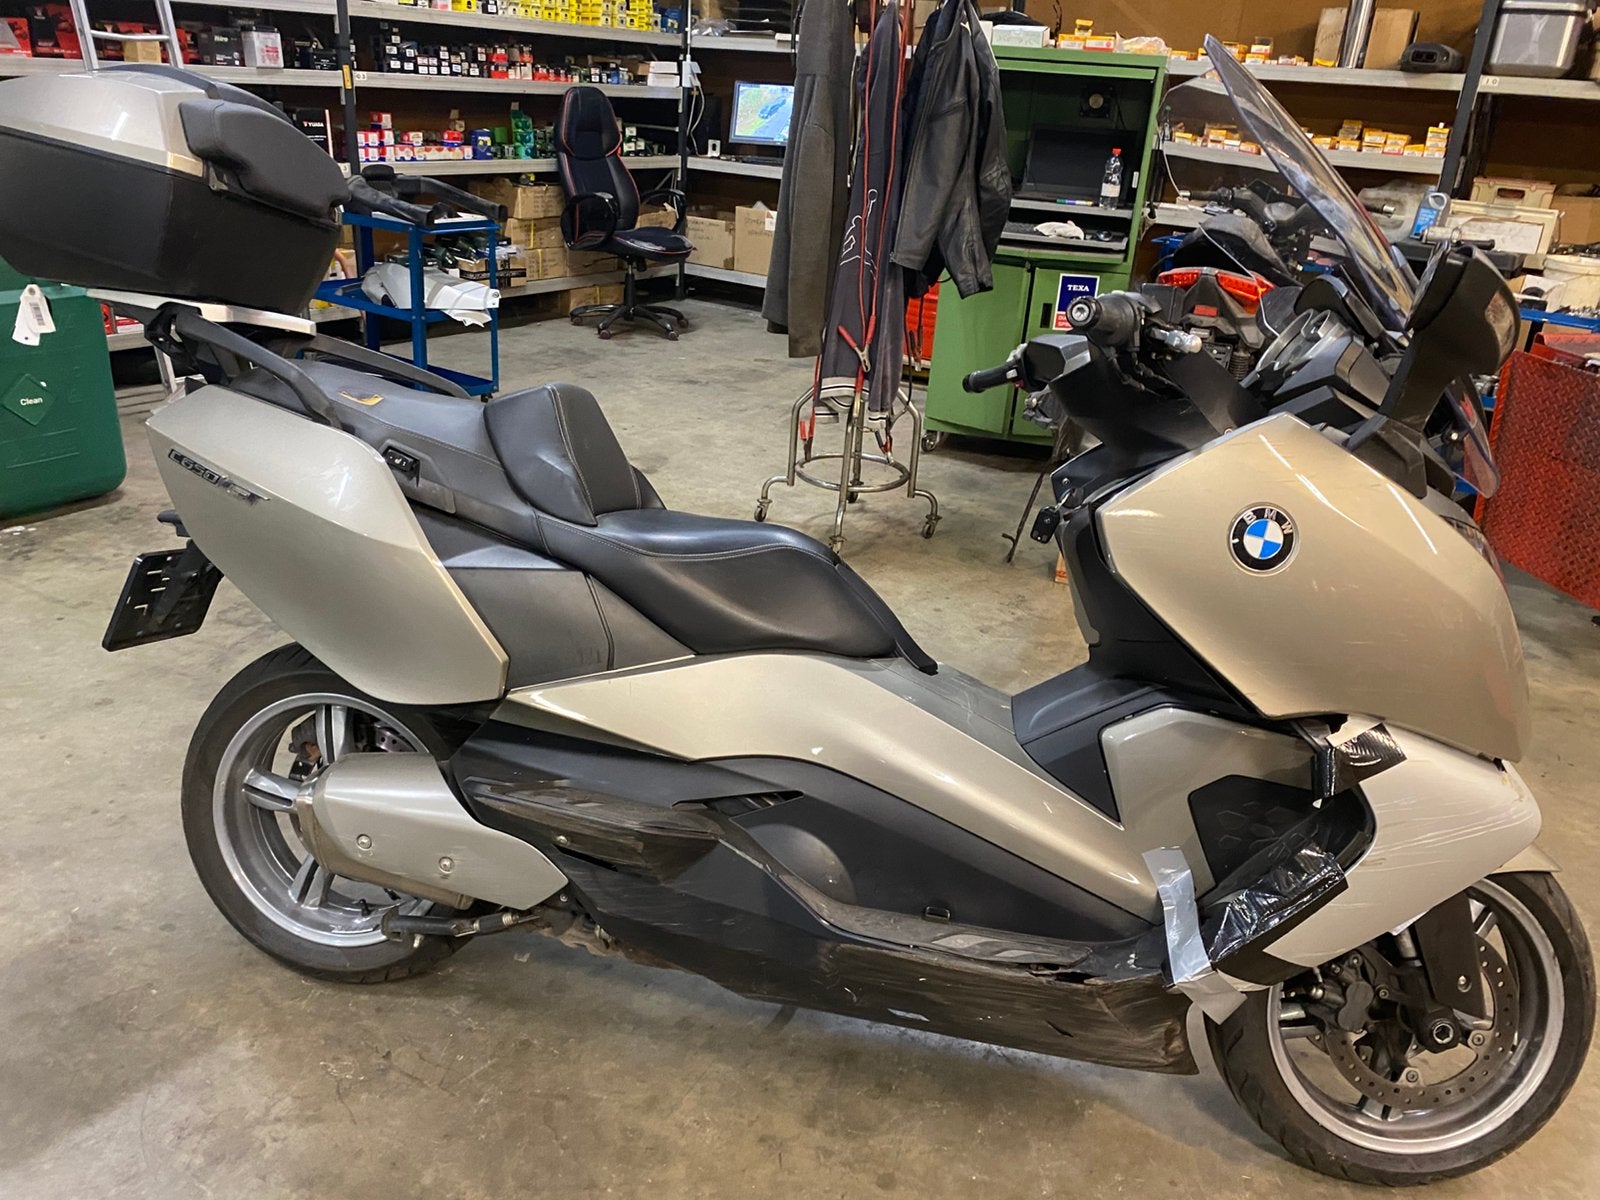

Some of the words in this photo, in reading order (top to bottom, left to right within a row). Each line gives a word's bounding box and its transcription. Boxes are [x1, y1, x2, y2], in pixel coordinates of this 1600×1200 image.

[1067, 284, 1089, 292] TEXA
[20, 397, 43, 406] Clean
[1243, 508, 1293, 534] BMW
